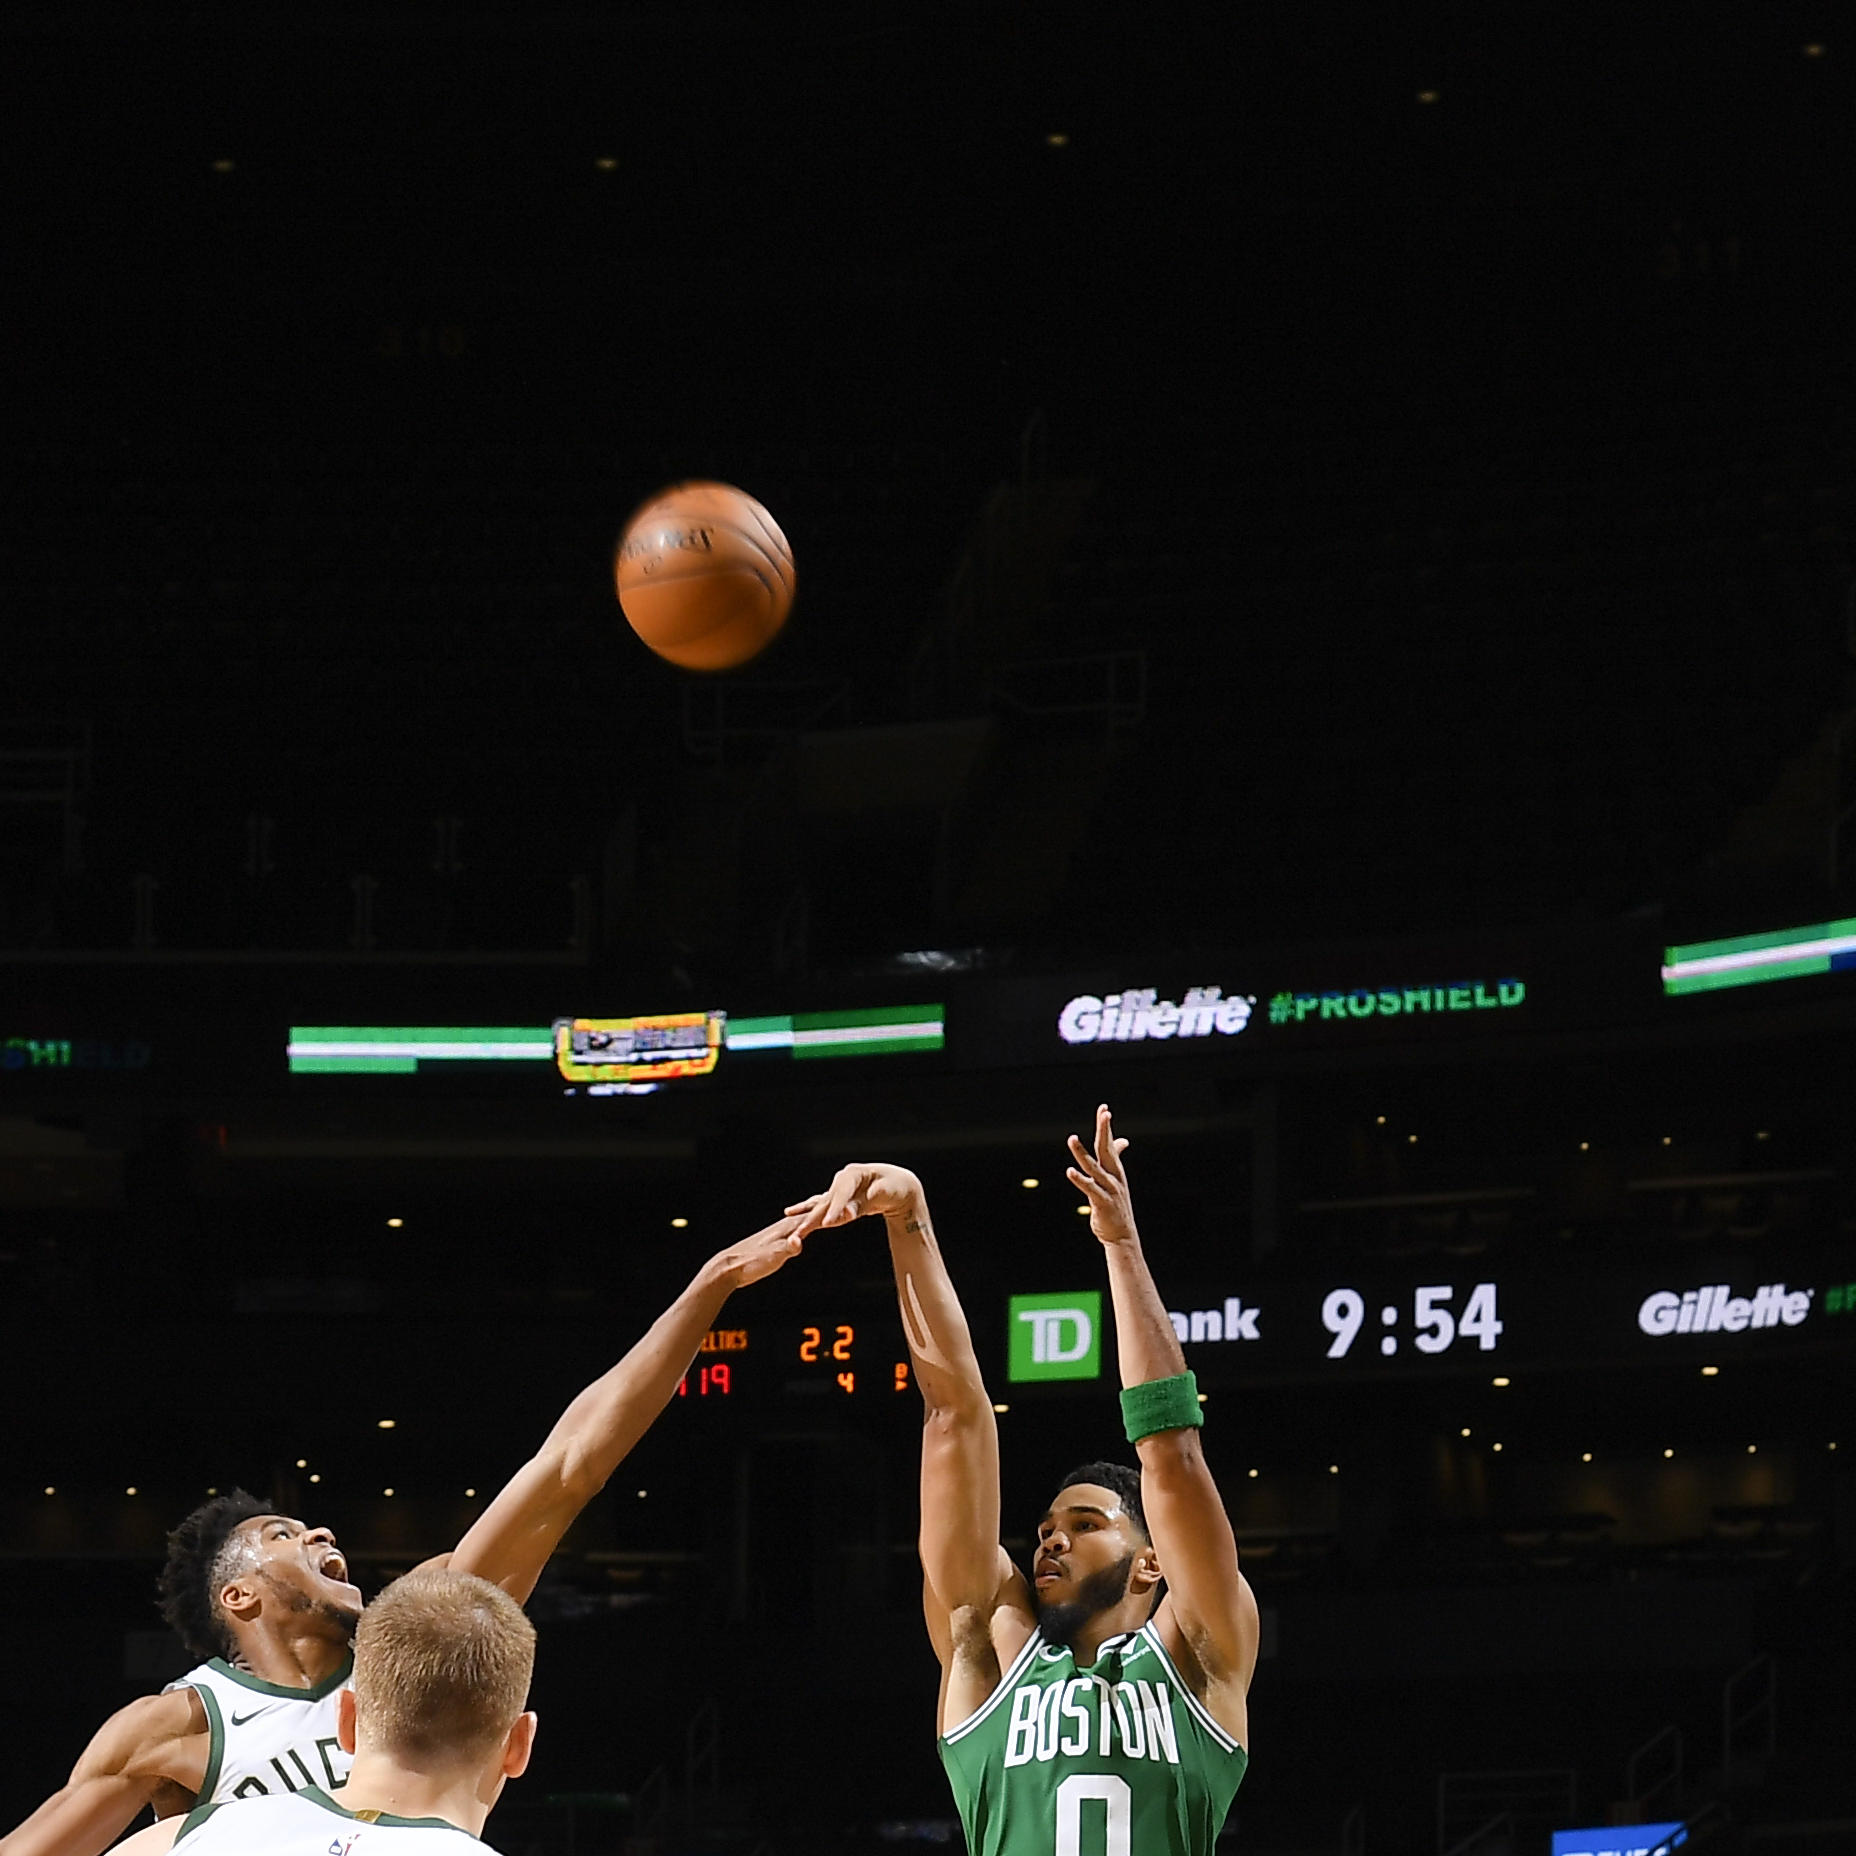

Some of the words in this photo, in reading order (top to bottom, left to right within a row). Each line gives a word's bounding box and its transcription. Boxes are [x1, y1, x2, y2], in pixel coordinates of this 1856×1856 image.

[1057, 983, 1258, 1045] Gillette
[1018, 1308, 1092, 1364] TD
[1167, 1297, 1262, 1344] ank
[1321, 1283, 1504, 1359] 9:54
[1637, 1281, 1816, 1337] Gillette
[799, 1325, 854, 1362] 2.2
[1004, 1674, 1180, 1769] BOSTON
